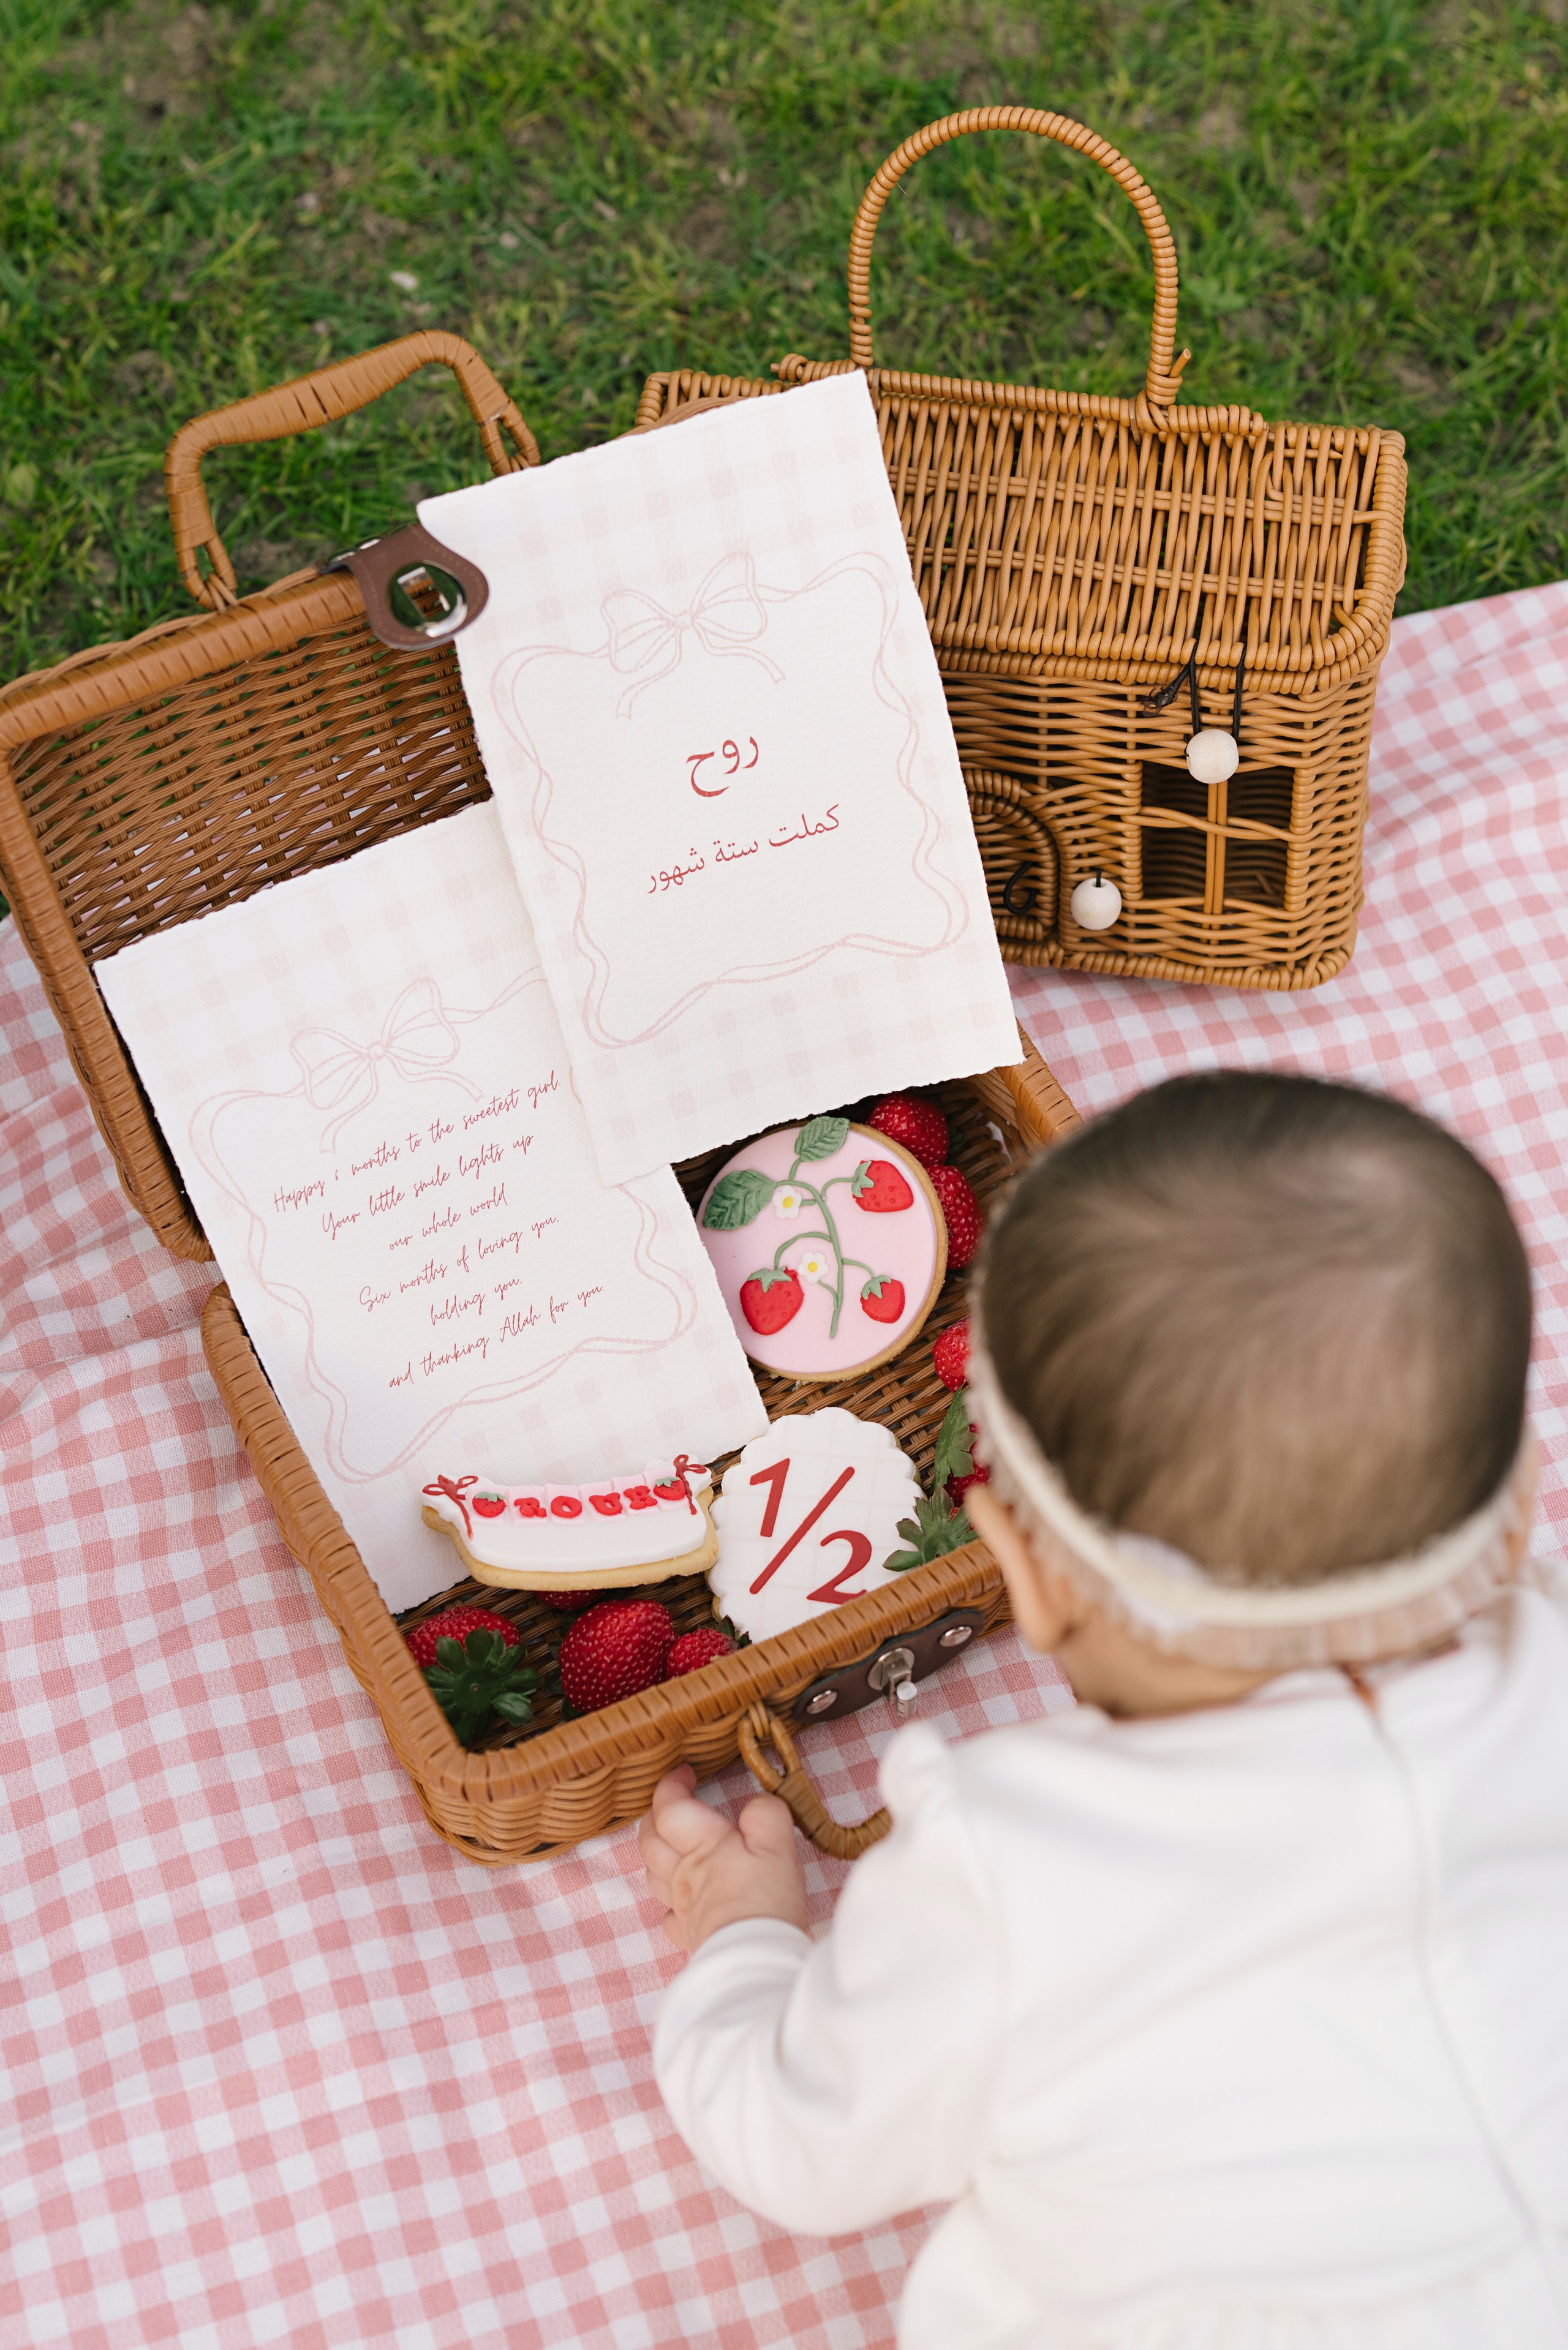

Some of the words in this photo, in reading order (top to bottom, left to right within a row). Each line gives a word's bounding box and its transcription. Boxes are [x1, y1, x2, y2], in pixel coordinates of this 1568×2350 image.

[686, 736, 759, 797] روح
[712, 840, 758, 862] ستة
[769, 804, 839, 848] كملت
[647, 847, 705, 894] شهور
[274, 1180, 325, 1212] Happy
[352, 1140, 401, 1175] months
[405, 1132, 422, 1153] to
[428, 1118, 454, 1143] the
[462, 1088, 520, 1130] sweetest
[322, 1211, 360, 1240] Your
[369, 1184, 405, 1216] little
[413, 1165, 451, 1198] smile
[459, 1143, 504, 1180] lights
[513, 1134, 533, 1155] up
[390, 1233, 413, 1251] our
[422, 1207, 461, 1238] whole
[359, 1286, 391, 1312] Six
[399, 1259, 448, 1294] months
[456, 1245, 470, 1273] of
[478, 1231, 522, 1259] loving
[431, 1292, 486, 1326] holding
[390, 1362, 414, 1388] and
[419, 1335, 489, 1376] thanking
[499, 1305, 541, 1343] Allah
[549, 1296, 569, 1324] for
[750, 1458, 875, 1605] 1/2
